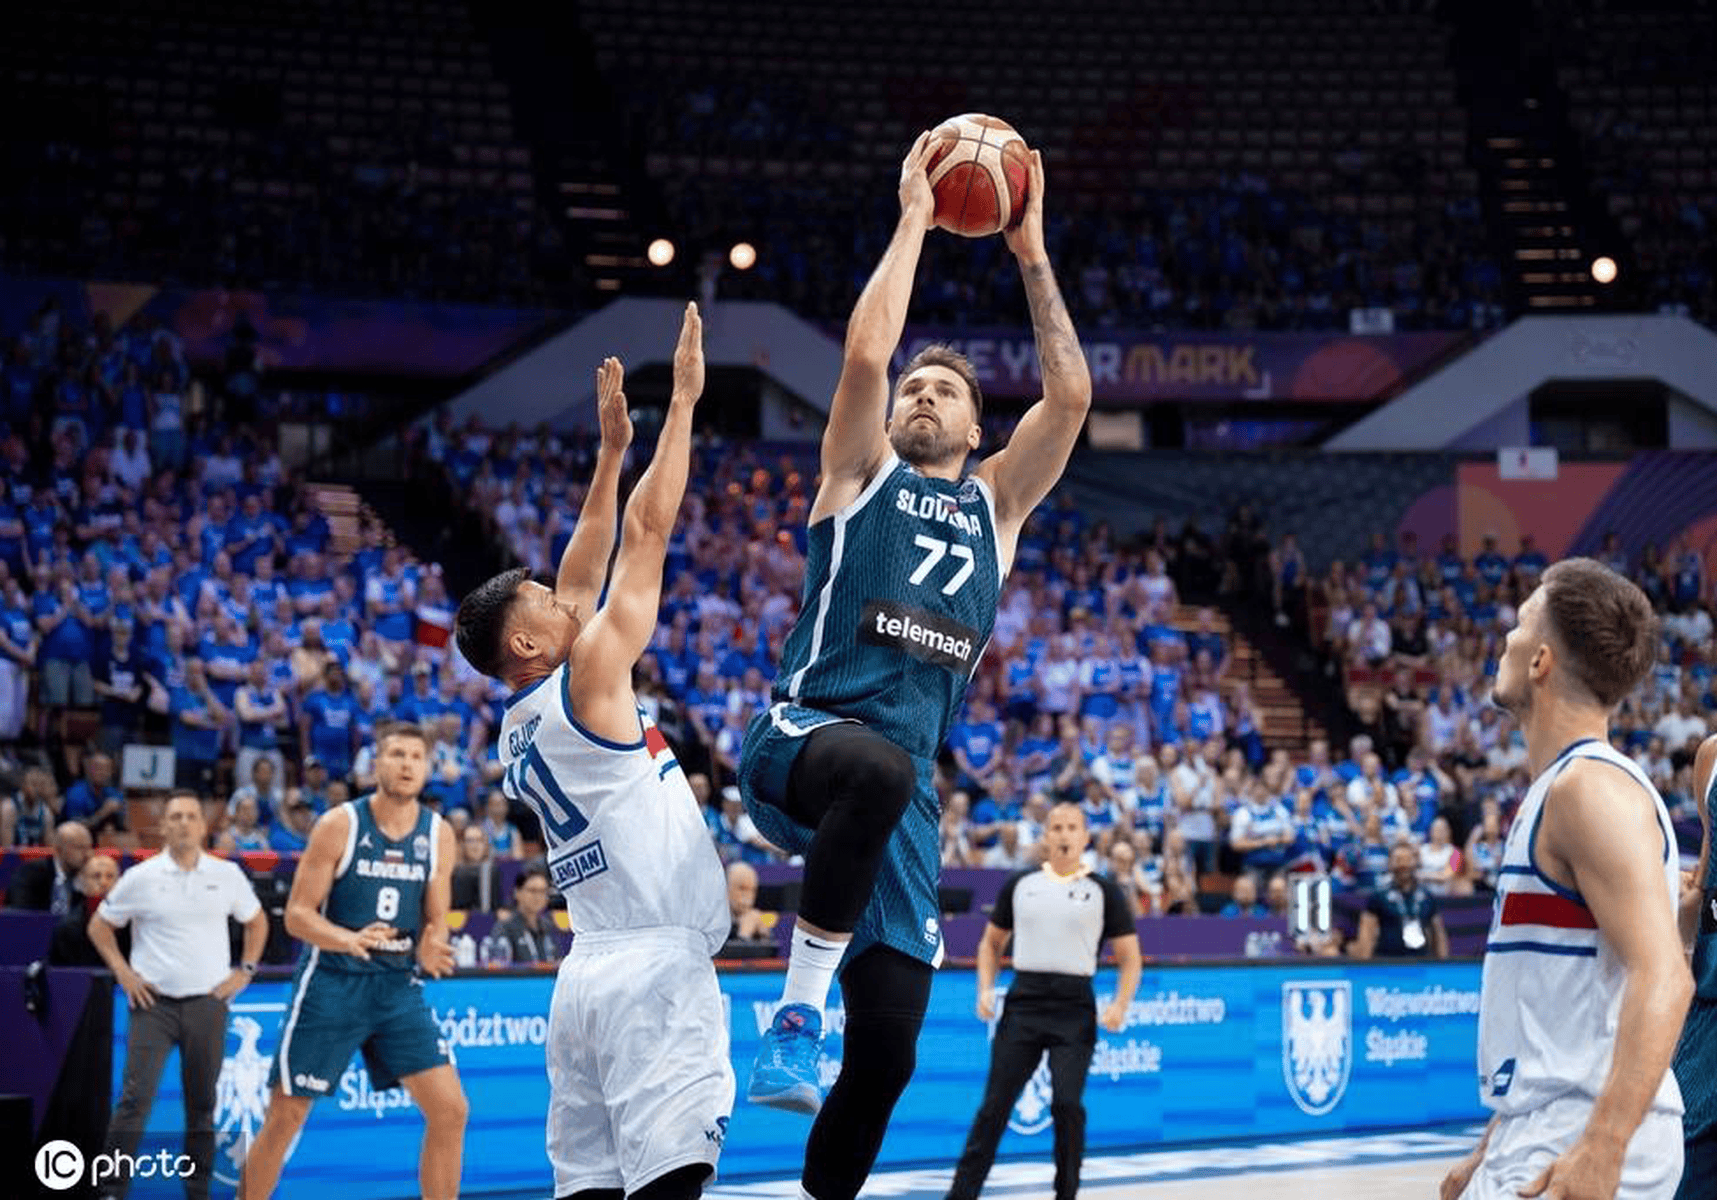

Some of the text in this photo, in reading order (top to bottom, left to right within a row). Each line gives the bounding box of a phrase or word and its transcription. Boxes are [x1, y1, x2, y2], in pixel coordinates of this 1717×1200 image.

[1125, 344, 1258, 384] MARK
[908, 533, 975, 596] 77
[876, 611, 973, 662] telemach
[141, 752, 158, 781] J
[376, 886, 400, 920] 8
